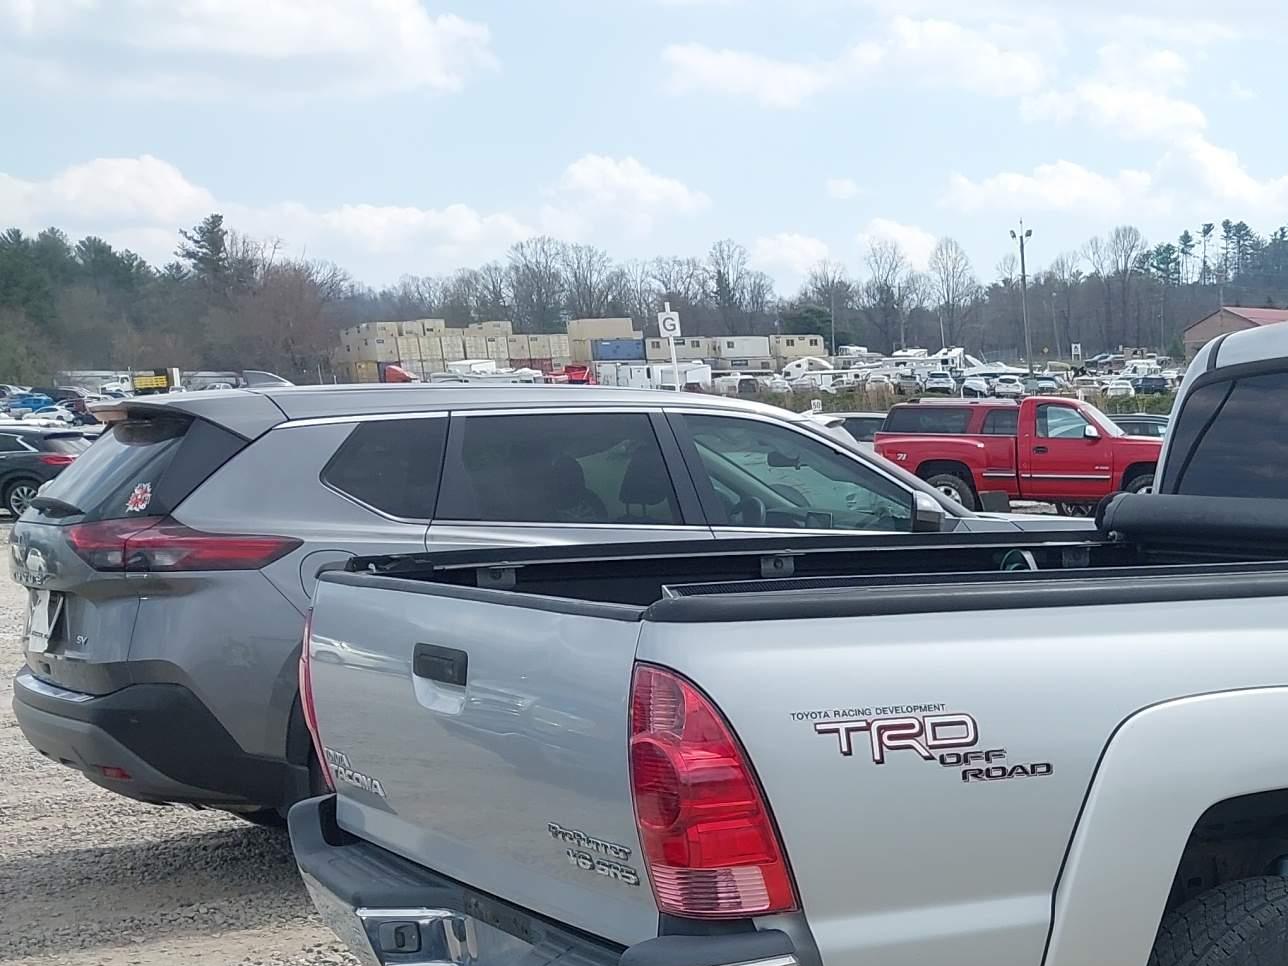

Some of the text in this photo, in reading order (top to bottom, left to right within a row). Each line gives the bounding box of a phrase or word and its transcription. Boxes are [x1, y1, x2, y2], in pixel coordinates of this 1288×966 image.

[662, 317, 676, 332] G
[76, 635, 88, 645] SV
[790, 703, 947, 721] TOYOTA RACING DEVELOPMENT
[814, 713, 979, 765] TRD
[939, 749, 1006, 767] OFF
[329, 763, 387, 798] TACOMA
[961, 762, 1053, 782] ROAD
[566, 848, 640, 886] V6 SR5
